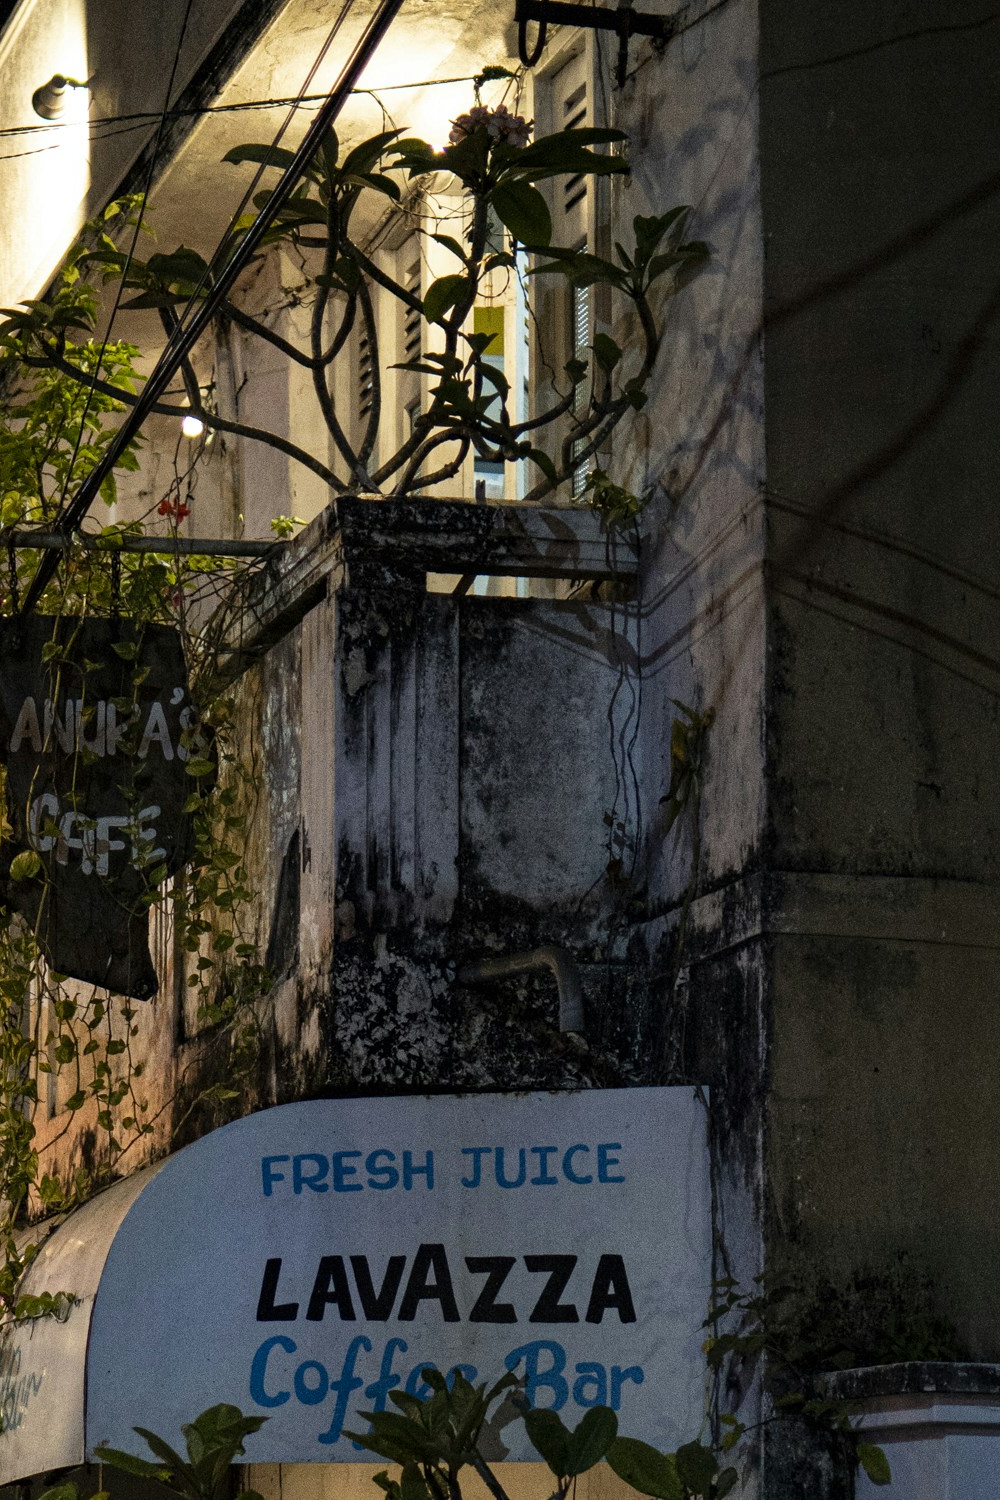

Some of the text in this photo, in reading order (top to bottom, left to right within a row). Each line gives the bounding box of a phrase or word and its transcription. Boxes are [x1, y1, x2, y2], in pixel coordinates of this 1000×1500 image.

[29, 793, 167, 876] CAFE
[261, 1143, 626, 1197] FRESH JUICE
[256, 1243, 637, 1324] LAVAZZA
[504, 1340, 644, 1411] Bar
